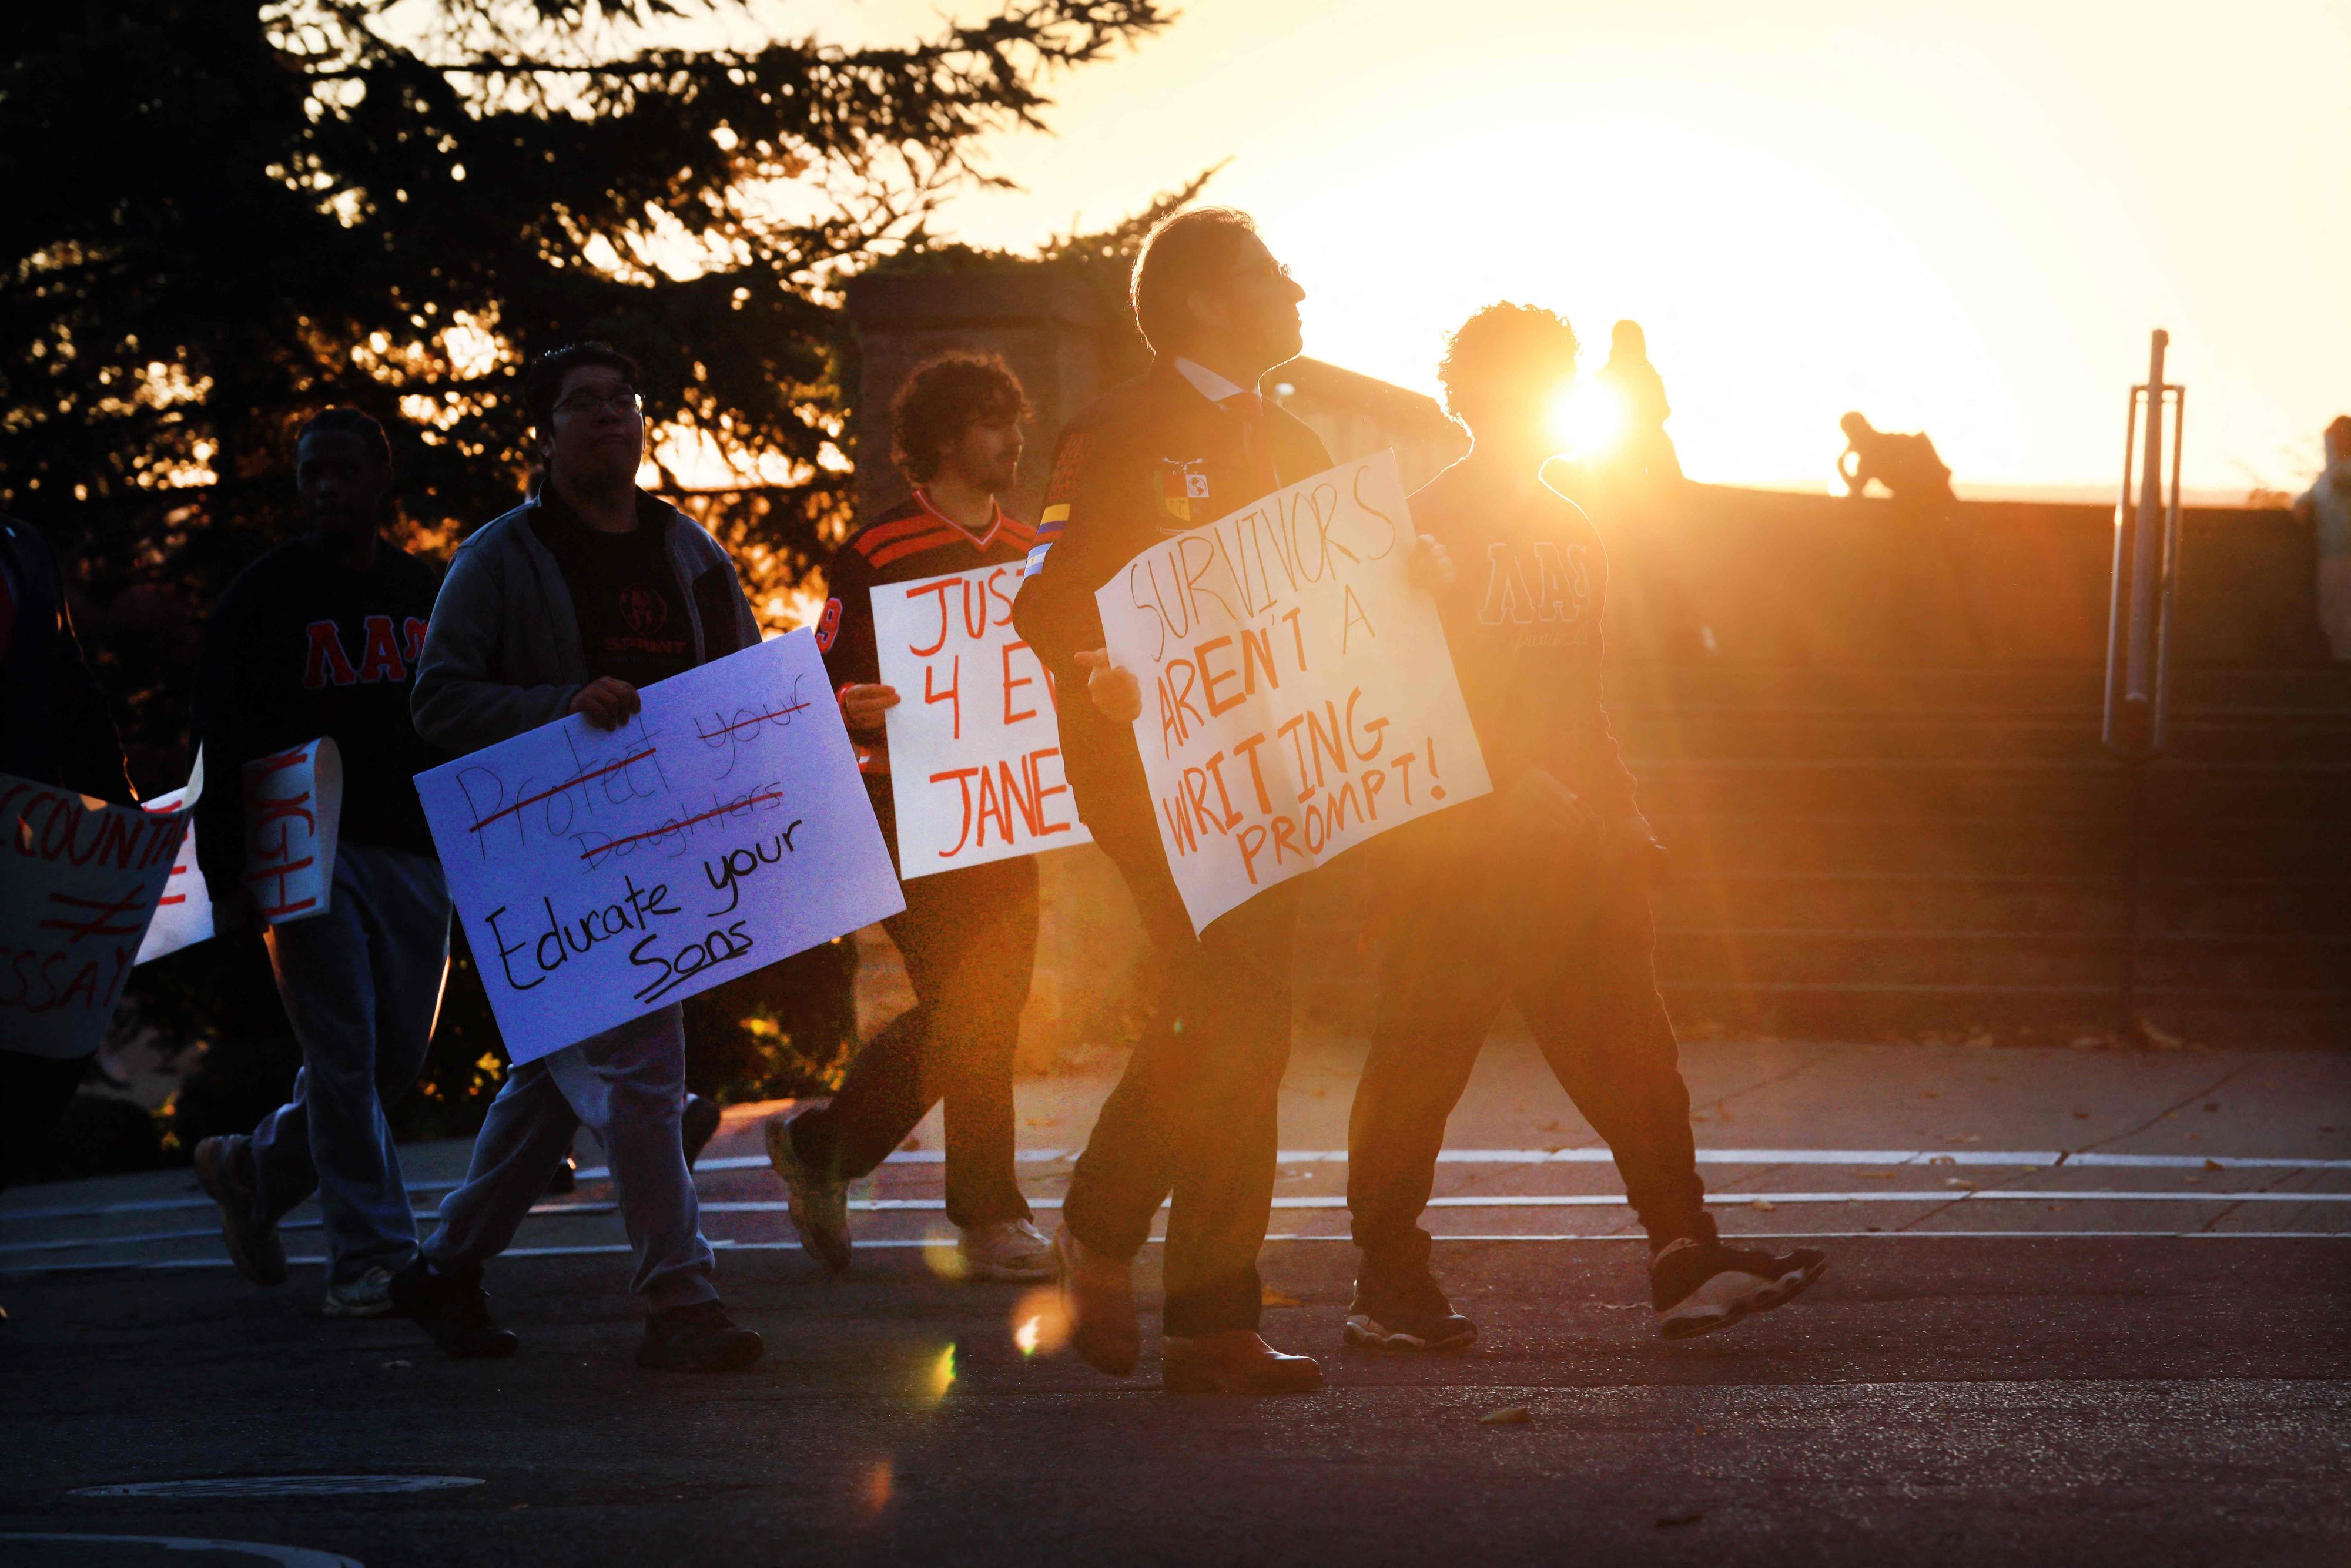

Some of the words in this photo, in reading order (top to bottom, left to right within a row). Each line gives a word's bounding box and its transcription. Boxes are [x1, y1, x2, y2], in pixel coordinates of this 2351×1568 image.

[906, 568, 1024, 658] JUS
[1130, 464, 1396, 662] SURVIVORS
[816, 597, 843, 655] 9
[1157, 607, 1307, 760] AREN'T
[1342, 583, 1376, 655] A
[924, 654, 960, 740] 4
[454, 716, 669, 860] Protect
[693, 672, 811, 780] your
[929, 746, 1071, 858] JANE
[1161, 686, 1391, 857] WRITING
[1235, 736, 1447, 885] PROMPT!
[568, 781, 783, 875] Daughters
[485, 875, 681, 990] Educate
[704, 819, 802, 917] your
[629, 919, 755, 978] Sons
[0, 939, 142, 1013] SSAY
